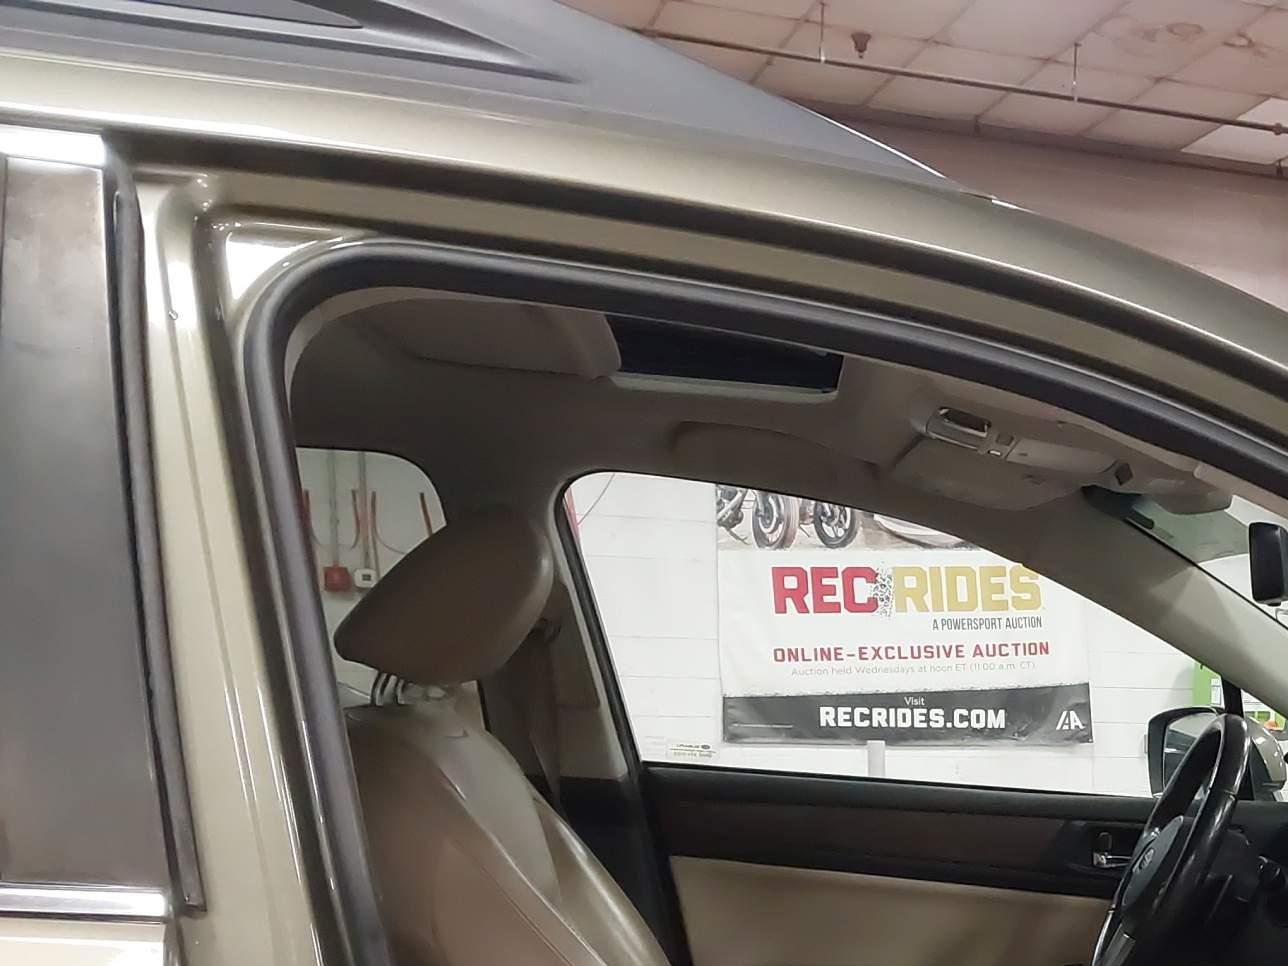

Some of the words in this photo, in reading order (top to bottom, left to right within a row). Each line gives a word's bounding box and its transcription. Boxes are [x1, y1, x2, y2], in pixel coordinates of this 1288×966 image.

[771, 566, 879, 614] REC
[892, 565, 1042, 613] RIDES
[932, 618, 940, 631] A
[941, 617, 1002, 631] POWERSPORT
[1005, 616, 1043, 630] AUCTION
[773, 645, 966, 663] ONLINE-EXCLUSIVE
[972, 641, 1050, 659] AUCTION
[791, 667, 829, 676] Auction
[831, 665, 852, 675] held
[854, 664, 915, 675] Wednesdays
[918, 664, 927, 673] at
[930, 664, 953, 673] noon
[955, 663, 966, 672] ET
[970, 662, 996, 672] (1100
[904, 696, 925, 706] Visit
[819, 706, 1006, 730] RECRIDES.COM
